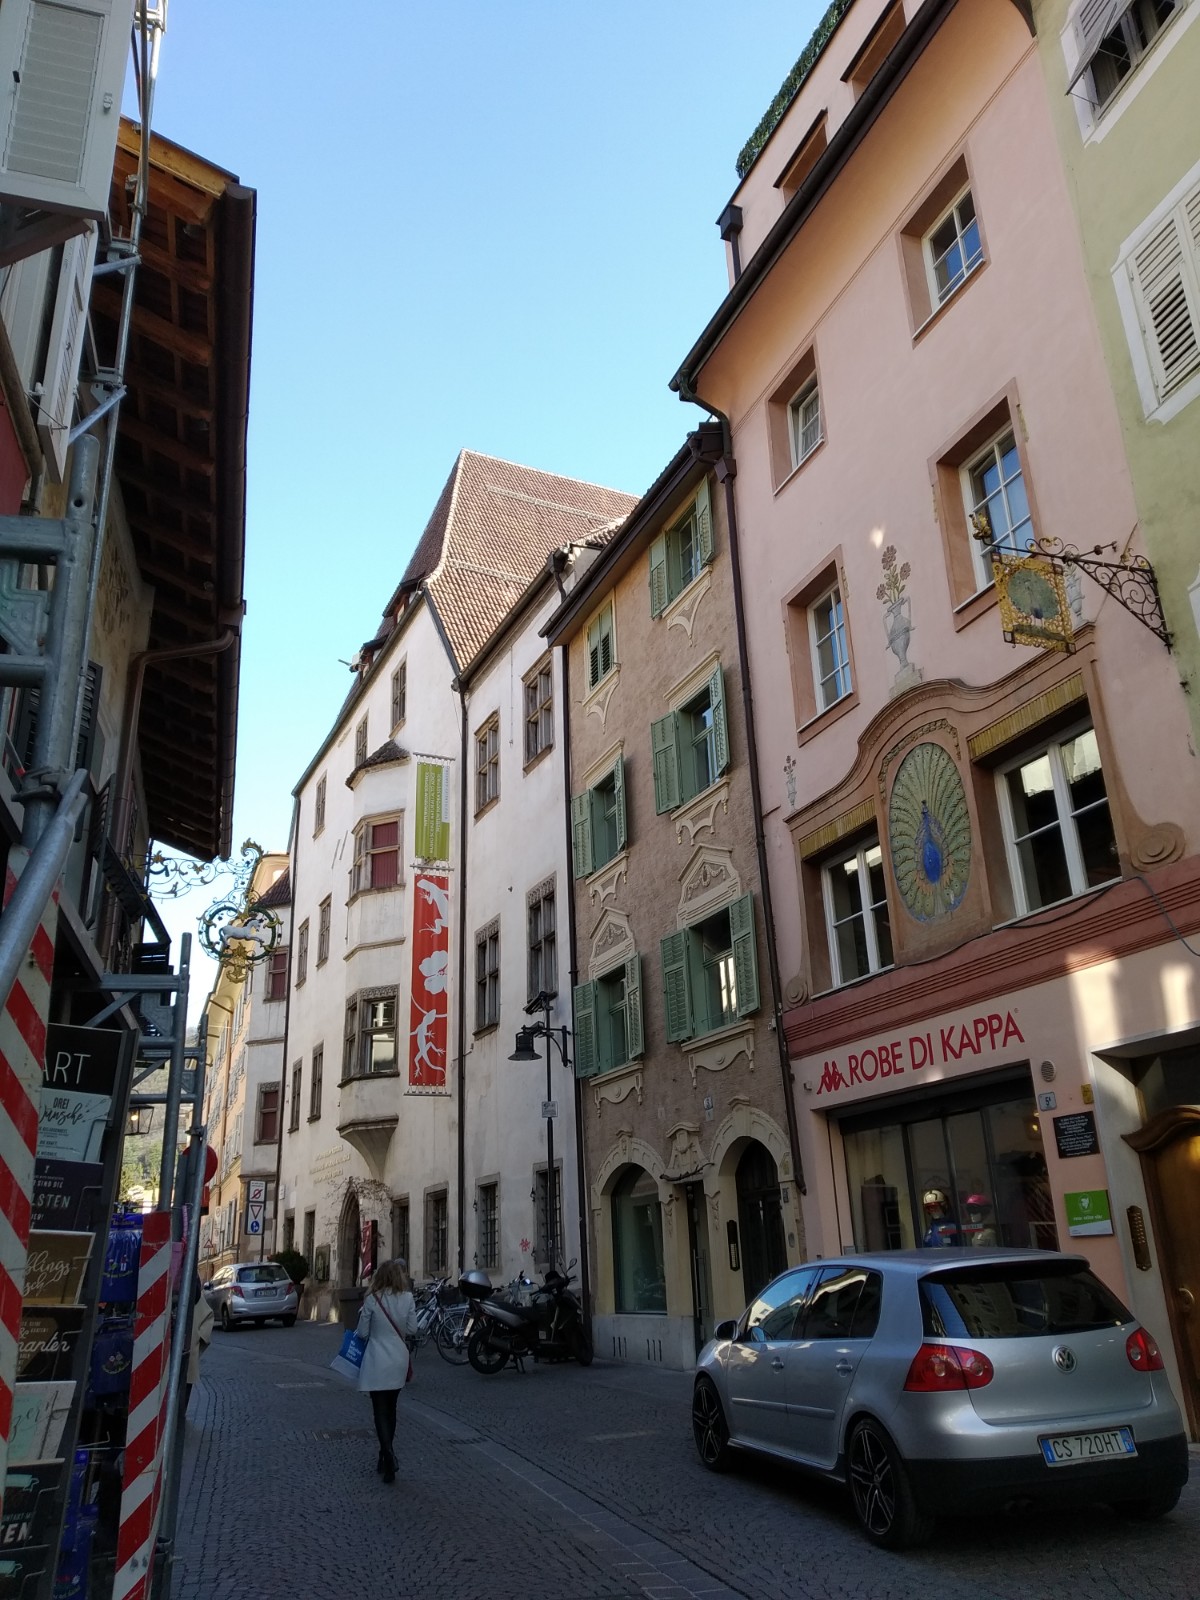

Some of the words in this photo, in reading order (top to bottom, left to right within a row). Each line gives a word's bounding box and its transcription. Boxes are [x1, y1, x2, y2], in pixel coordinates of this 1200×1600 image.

[848, 1041, 905, 1086] ROBE
[909, 1033, 935, 1070] DI
[940, 1010, 1025, 1063] KAPPA
[52, 1097, 70, 1110] DREI
[1052, 1439, 1073, 1459] CS
[1074, 1433, 1122, 1456] 720HT
